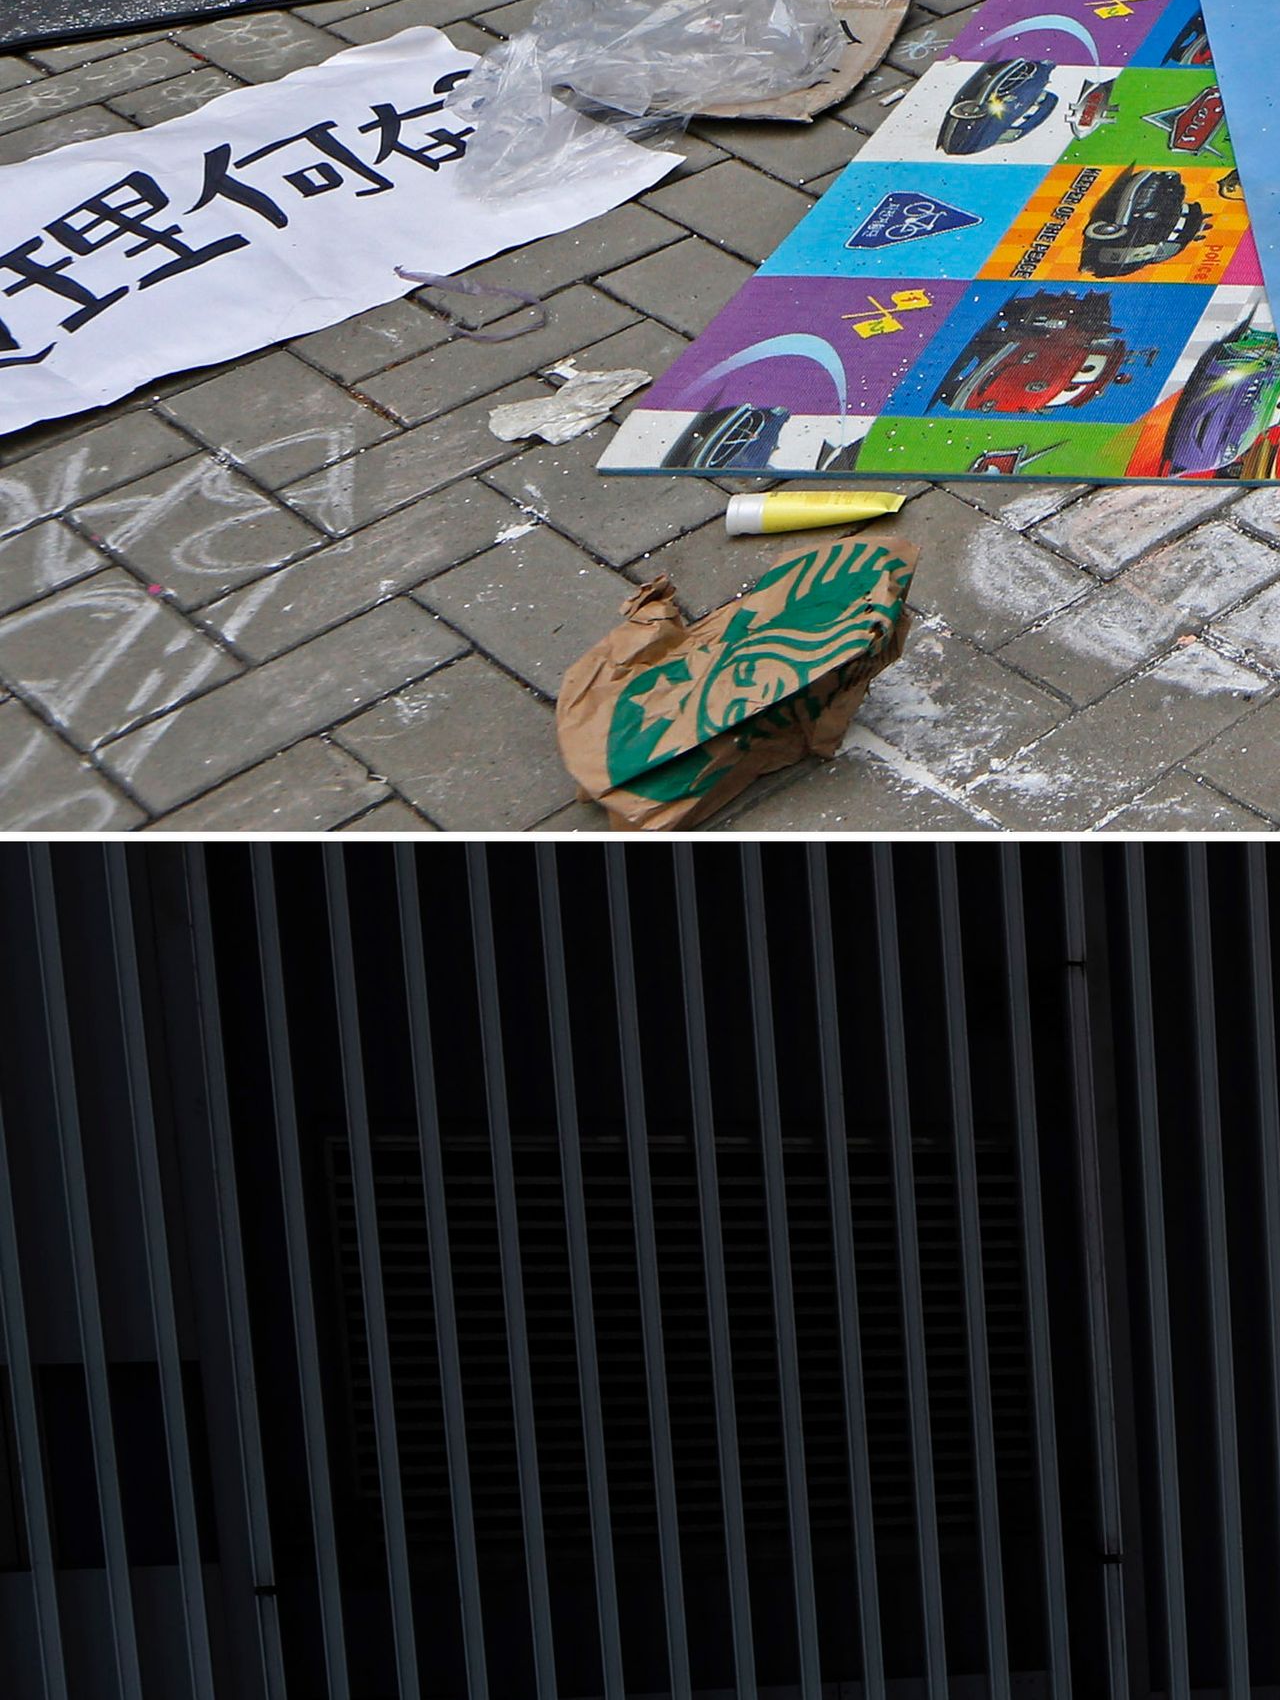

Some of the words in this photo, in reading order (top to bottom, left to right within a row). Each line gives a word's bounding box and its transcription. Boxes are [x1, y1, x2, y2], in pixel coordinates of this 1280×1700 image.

[1059, 167, 1103, 206] KEEPER
[1034, 218, 1067, 243] THE
[1051, 204, 1076, 221] OF
[1008, 240, 1050, 280] PEACE
[1188, 243, 1222, 282] police
